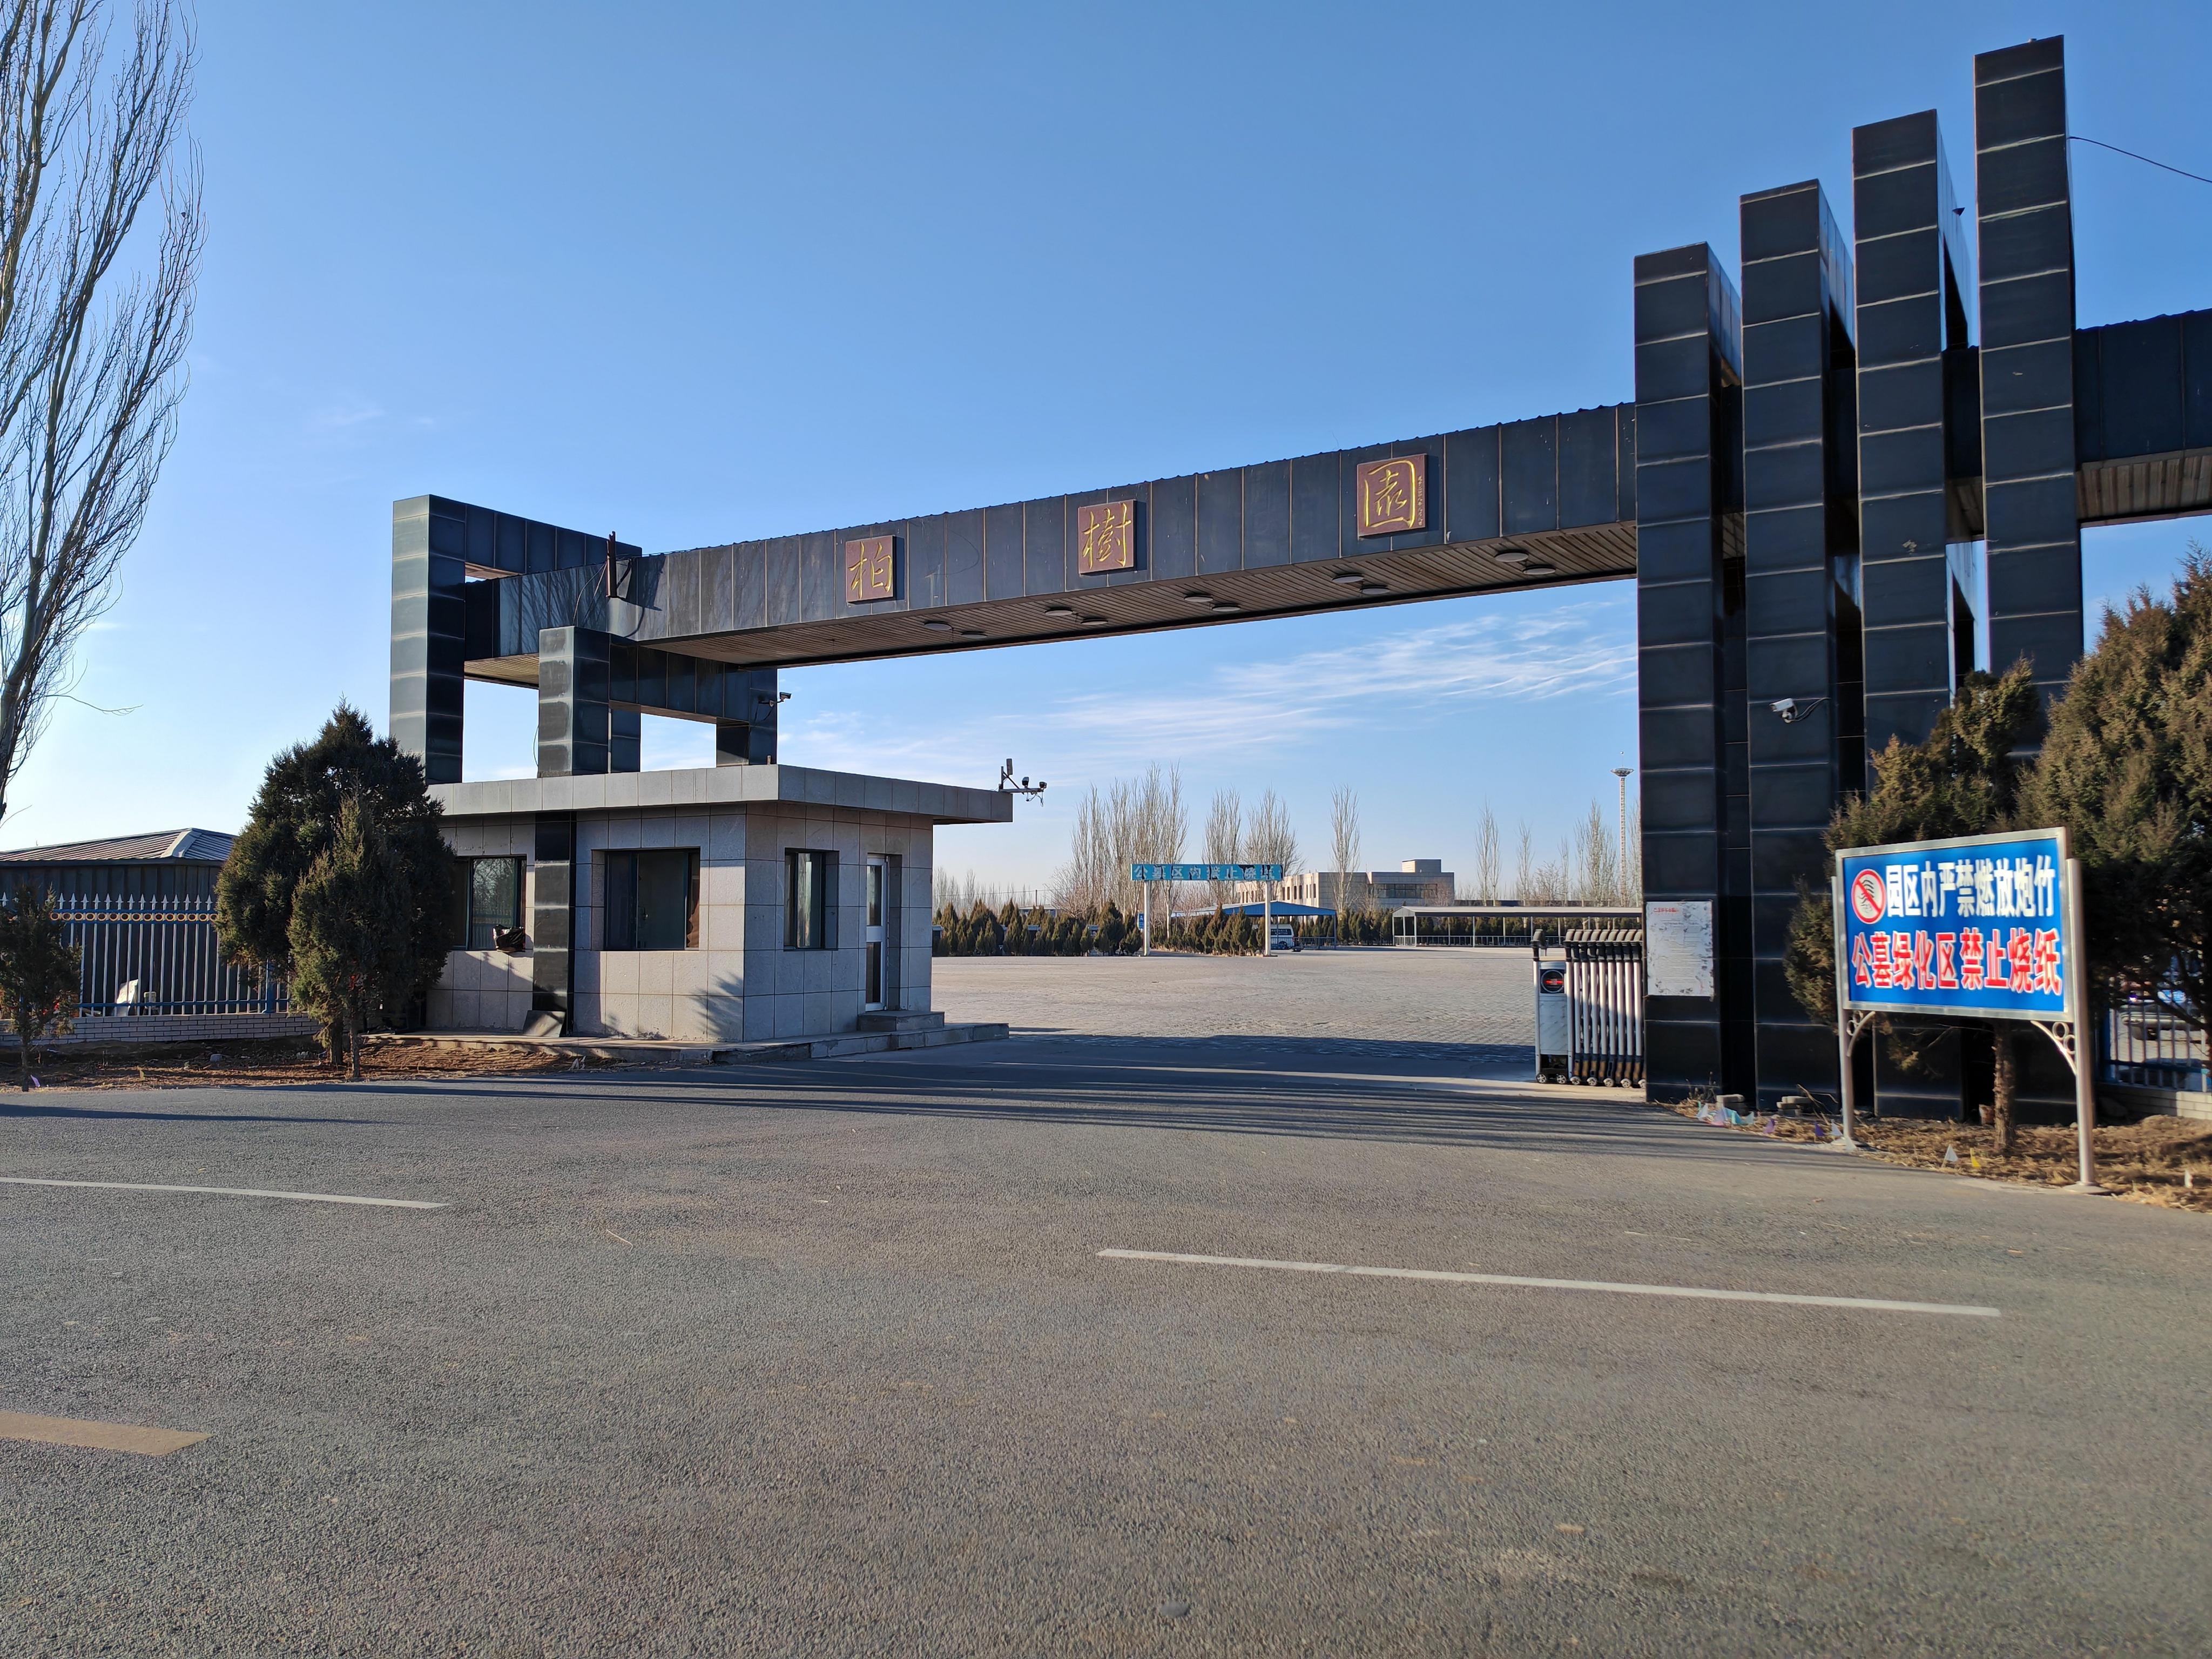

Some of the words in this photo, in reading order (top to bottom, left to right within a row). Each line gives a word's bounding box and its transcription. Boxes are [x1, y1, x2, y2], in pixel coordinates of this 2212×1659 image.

[1885, 855, 2055, 917] 园区内严禁燃放炮竹
[1851, 927, 2062, 995] 公墓绿化区禁止烧纸
